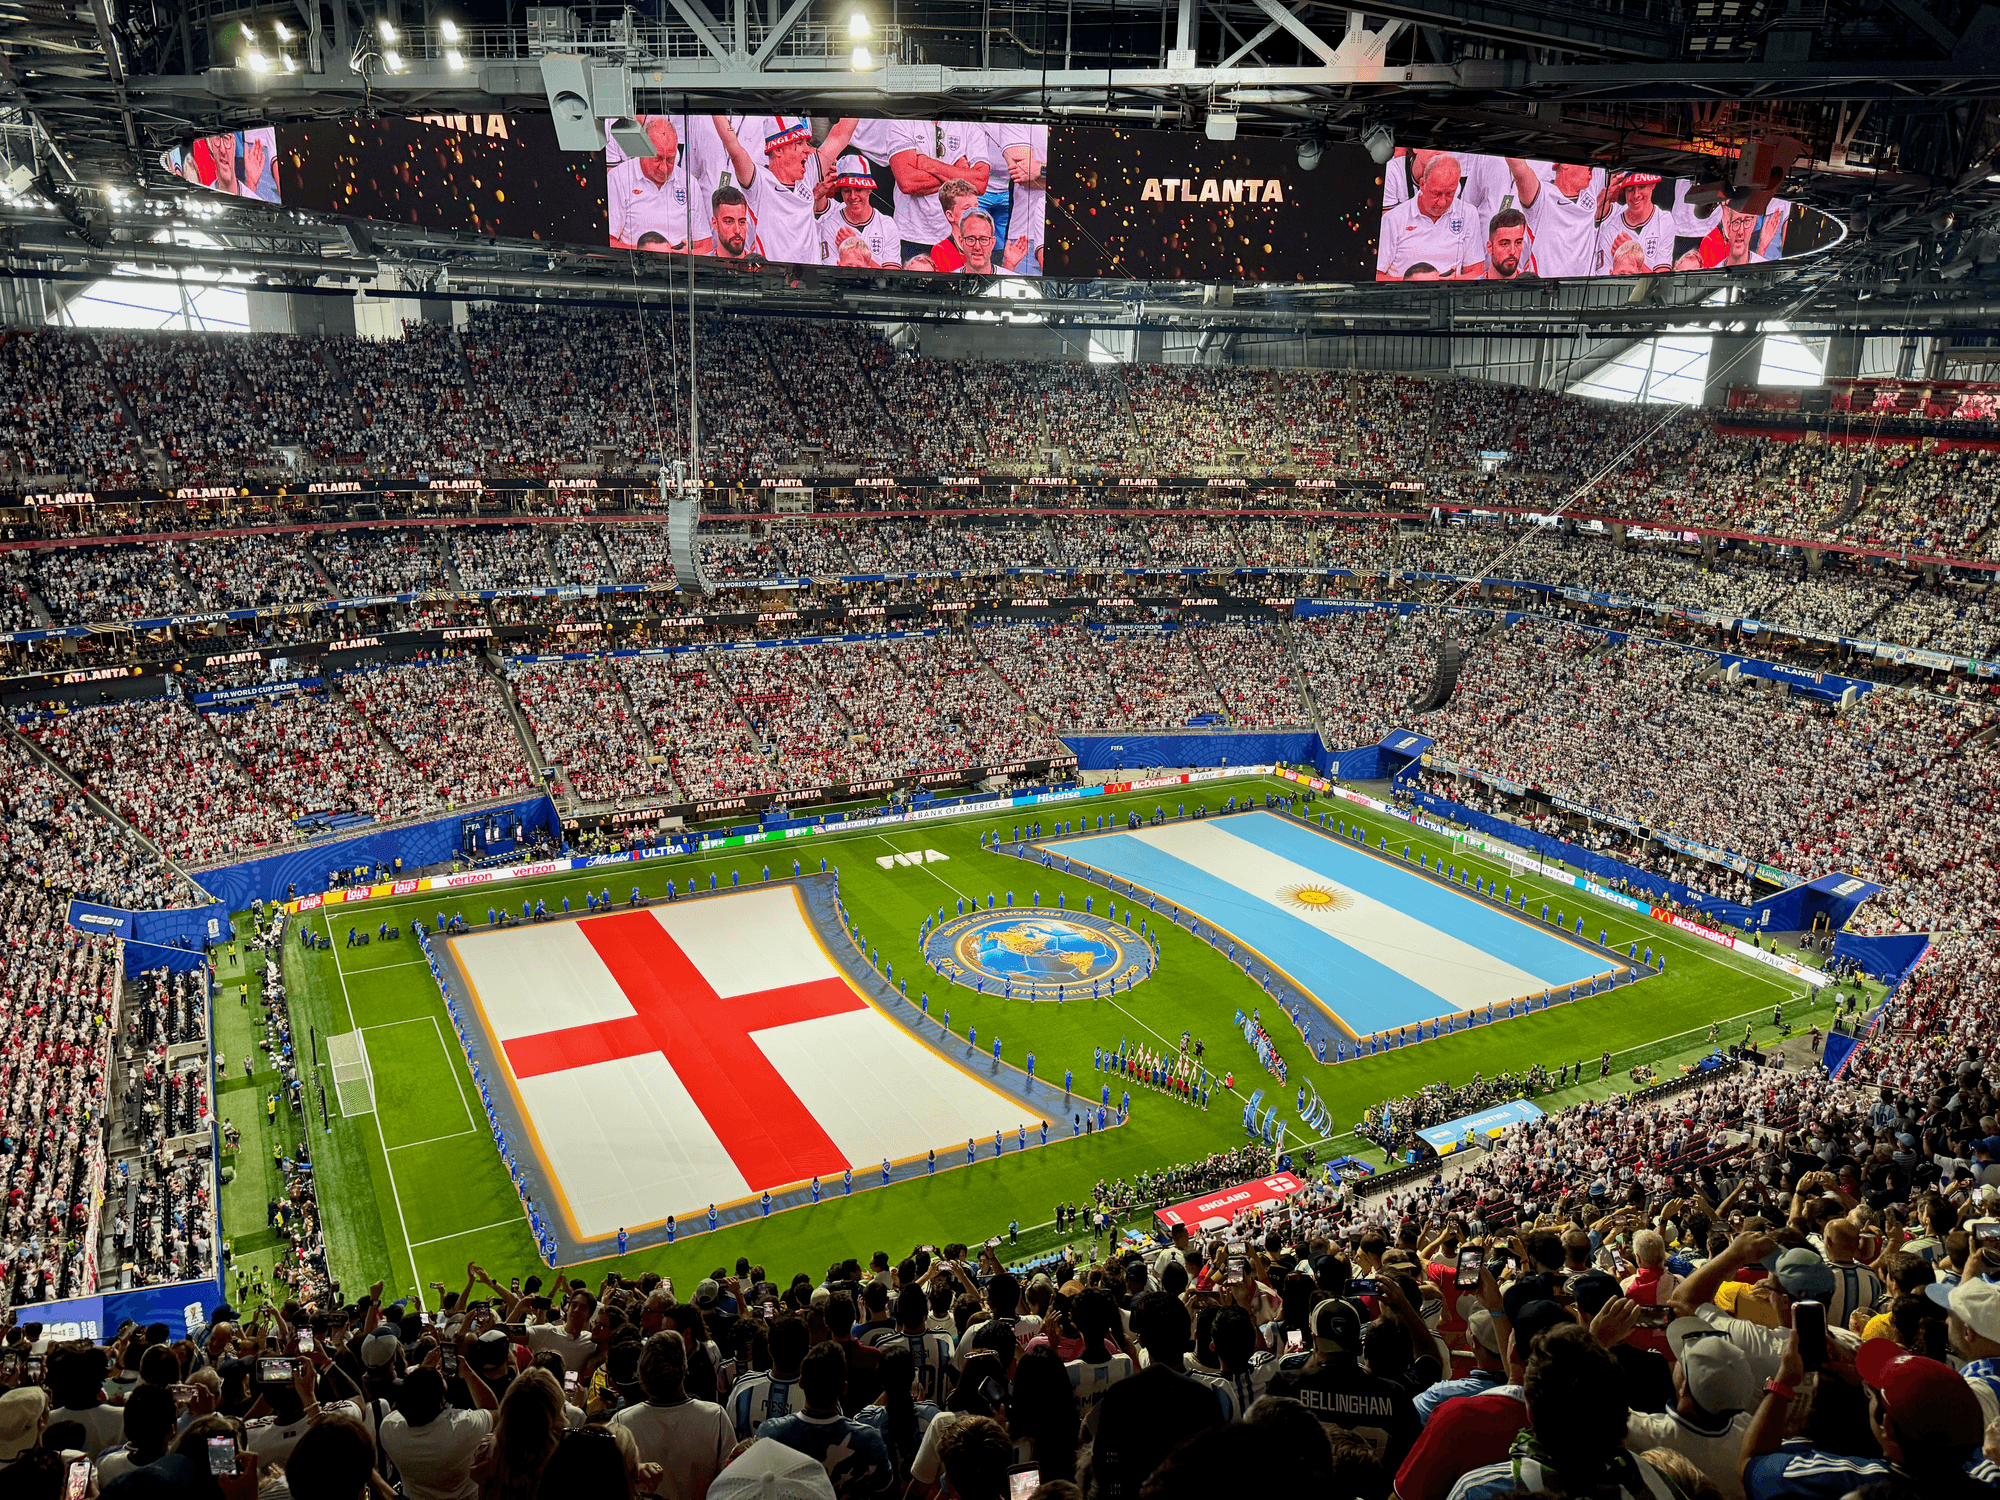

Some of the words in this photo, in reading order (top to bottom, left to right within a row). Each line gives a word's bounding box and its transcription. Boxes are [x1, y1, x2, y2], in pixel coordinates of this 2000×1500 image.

[1140, 178, 1284, 203] ATLANTA
[308, 482, 362, 493] ATLANTA
[429, 480, 483, 489] ATLANTA
[548, 479, 598, 489] ATLANTA
[760, 479, 803, 488] ATLANTA
[854, 478, 895, 487] ATLANTA
[1028, 477, 1069, 485] ATLANTA
[1118, 478, 1158, 486] ATLANTA
[1207, 479, 1246, 487] ATLANTA
[1294, 479, 1337, 488] ATLANTA
[24, 492, 96, 506] ATLANTA
[176, 487, 237, 499] ATLANTA
[758, 579, 779, 587] 2026
[932, 602, 968, 611] ATLANTA
[1011, 599, 1049, 607] ATLANTA
[1097, 598, 1134, 607] ATLANTA
[1181, 598, 1219, 606] ATLANTA
[757, 612, 798, 622] ATLANTA
[848, 606, 886, 616] ATLANTA
[170, 613, 229, 625] ATLANTA
[660, 617, 705, 628] ATLANTA
[442, 628, 494, 640] ATLANTA
[555, 622, 603, 633] ATLANTA
[1779, 626, 1802, 636] WORLD
[1816, 633, 1840, 643] 2026
[329, 637, 379, 651] ATLANTA
[205, 651, 262, 666] ATLANTA
[63, 667, 129, 684] ATLANTA
[212, 691, 230, 700] FIFA
[229, 688, 257, 698] WORLD
[257, 685, 273, 694] CUP
[273, 682, 299, 692] 2026
[985, 763, 1027, 776] ATLANTA
[919, 771, 962, 784] ATLANTA
[1130, 775, 1182, 790] McDonald's
[849, 780, 895, 794] ATLANTA
[775, 789, 822, 803] ATLANTA
[1037, 791, 1081, 803] Hisense
[1345, 792, 1371, 807] verizon
[696, 798, 746, 812] ATLANTA
[918, 809, 943, 819] BANK
[945, 807, 959, 815] OF
[959, 801, 1000, 813] AMERICA
[1566, 802, 1592, 817] WORLD
[1591, 809, 1607, 820] CUP
[611, 808, 666, 824] ATLANTA
[847, 819, 868, 828] STATES
[1416, 815, 1442, 834] ULTRA
[586, 851, 630, 867] Michelob
[642, 845, 684, 858] ULTRA
[876, 849, 950, 870] FIFA
[512, 863, 556, 877] verizon
[447, 872, 493, 886] verizon
[346, 887, 369, 901] Lay's
[394, 881, 417, 894] Lay's
[1584, 881, 1639, 911] Hisense
[1686, 890, 1703, 903] FIFA
[299, 895, 322, 911] Lay's
[1671, 915, 1733, 948] McDonald's
[1755, 950, 1784, 966] Dove
[1012, 987, 1044, 996] FIA
[1197, 1191, 1251, 1213] ENGLAND
[908, 1349, 930, 1360] ESSI
[1299, 1388, 1393, 1417] BELLINGHAM
